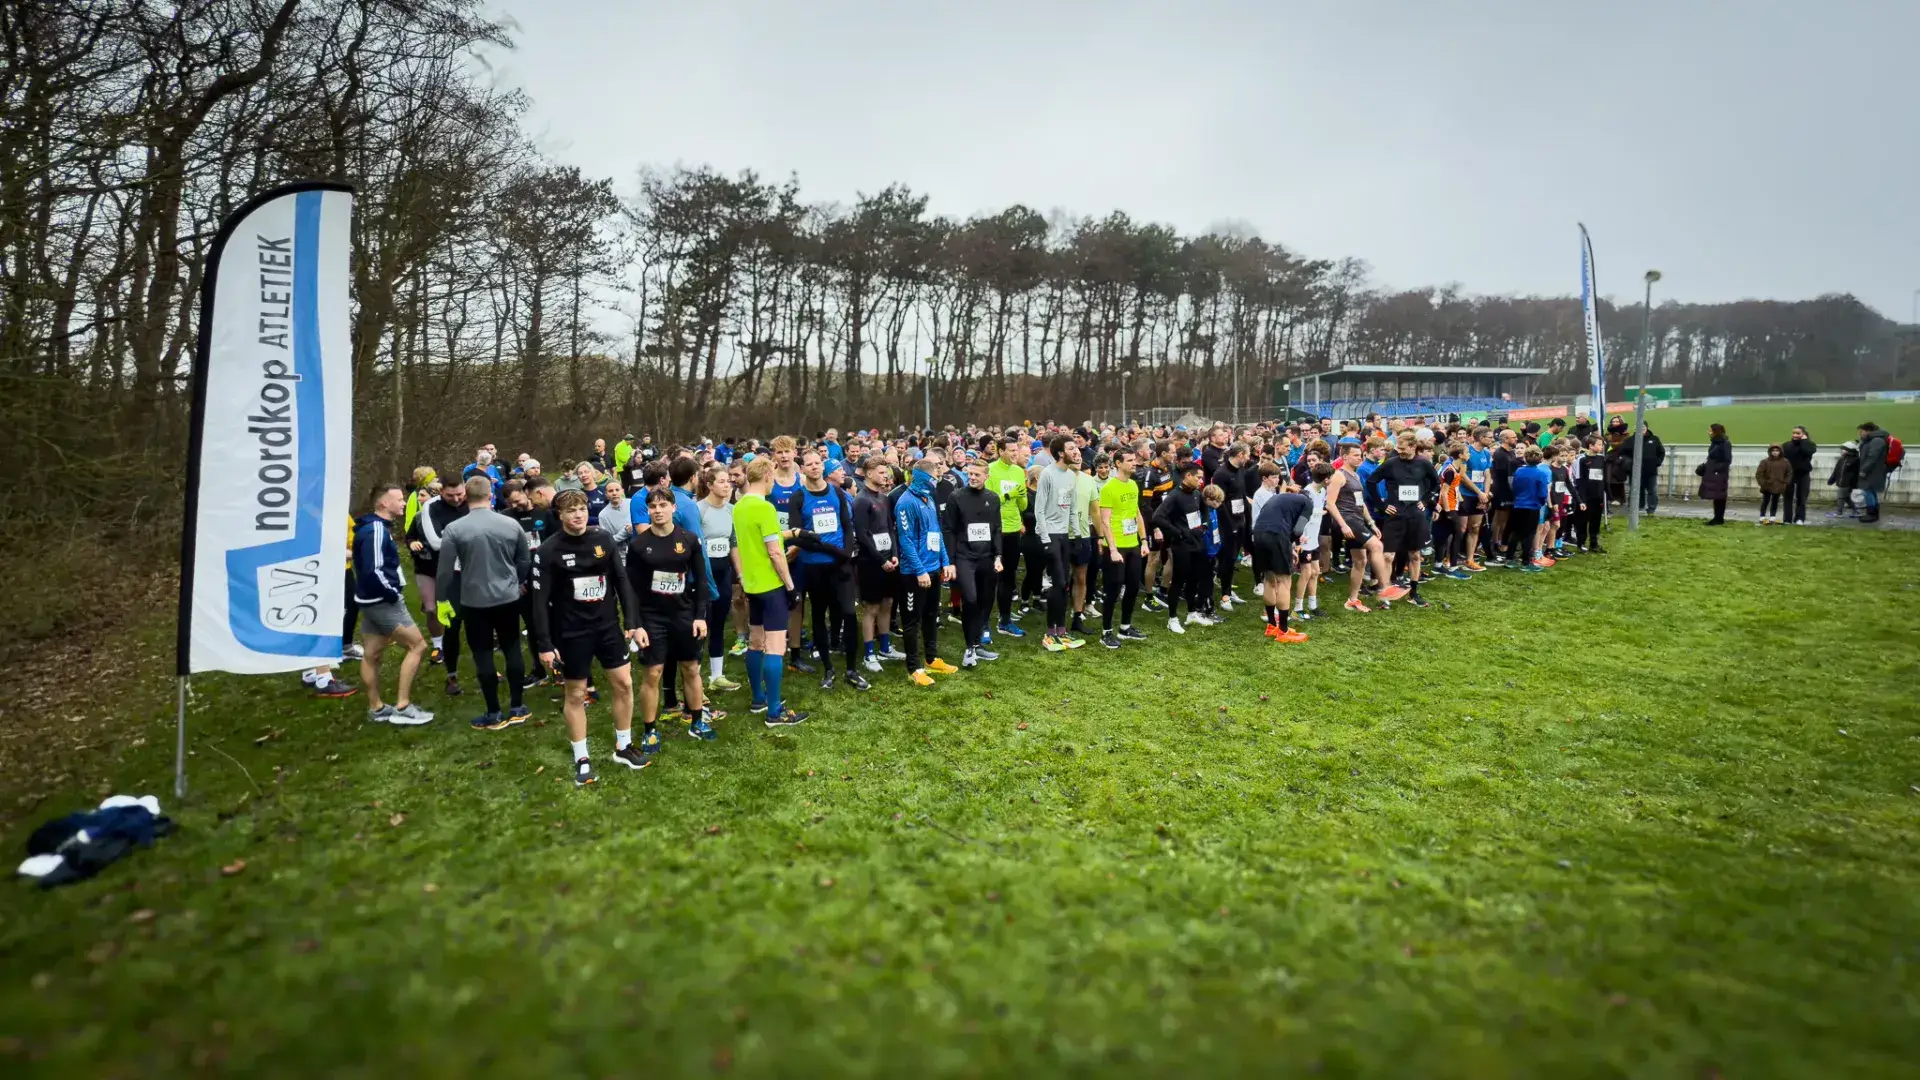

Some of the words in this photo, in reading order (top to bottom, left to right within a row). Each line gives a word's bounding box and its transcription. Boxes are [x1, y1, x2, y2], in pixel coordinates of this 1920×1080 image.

[257, 234, 291, 351] ATLETIEK
[247, 360, 302, 531] noordkop
[817, 518, 835, 528] 619
[971, 528, 986, 536] 685
[659, 580, 677, 592] 575
[266, 560, 319, 628] S.V.
[582, 587, 601, 598] 402
